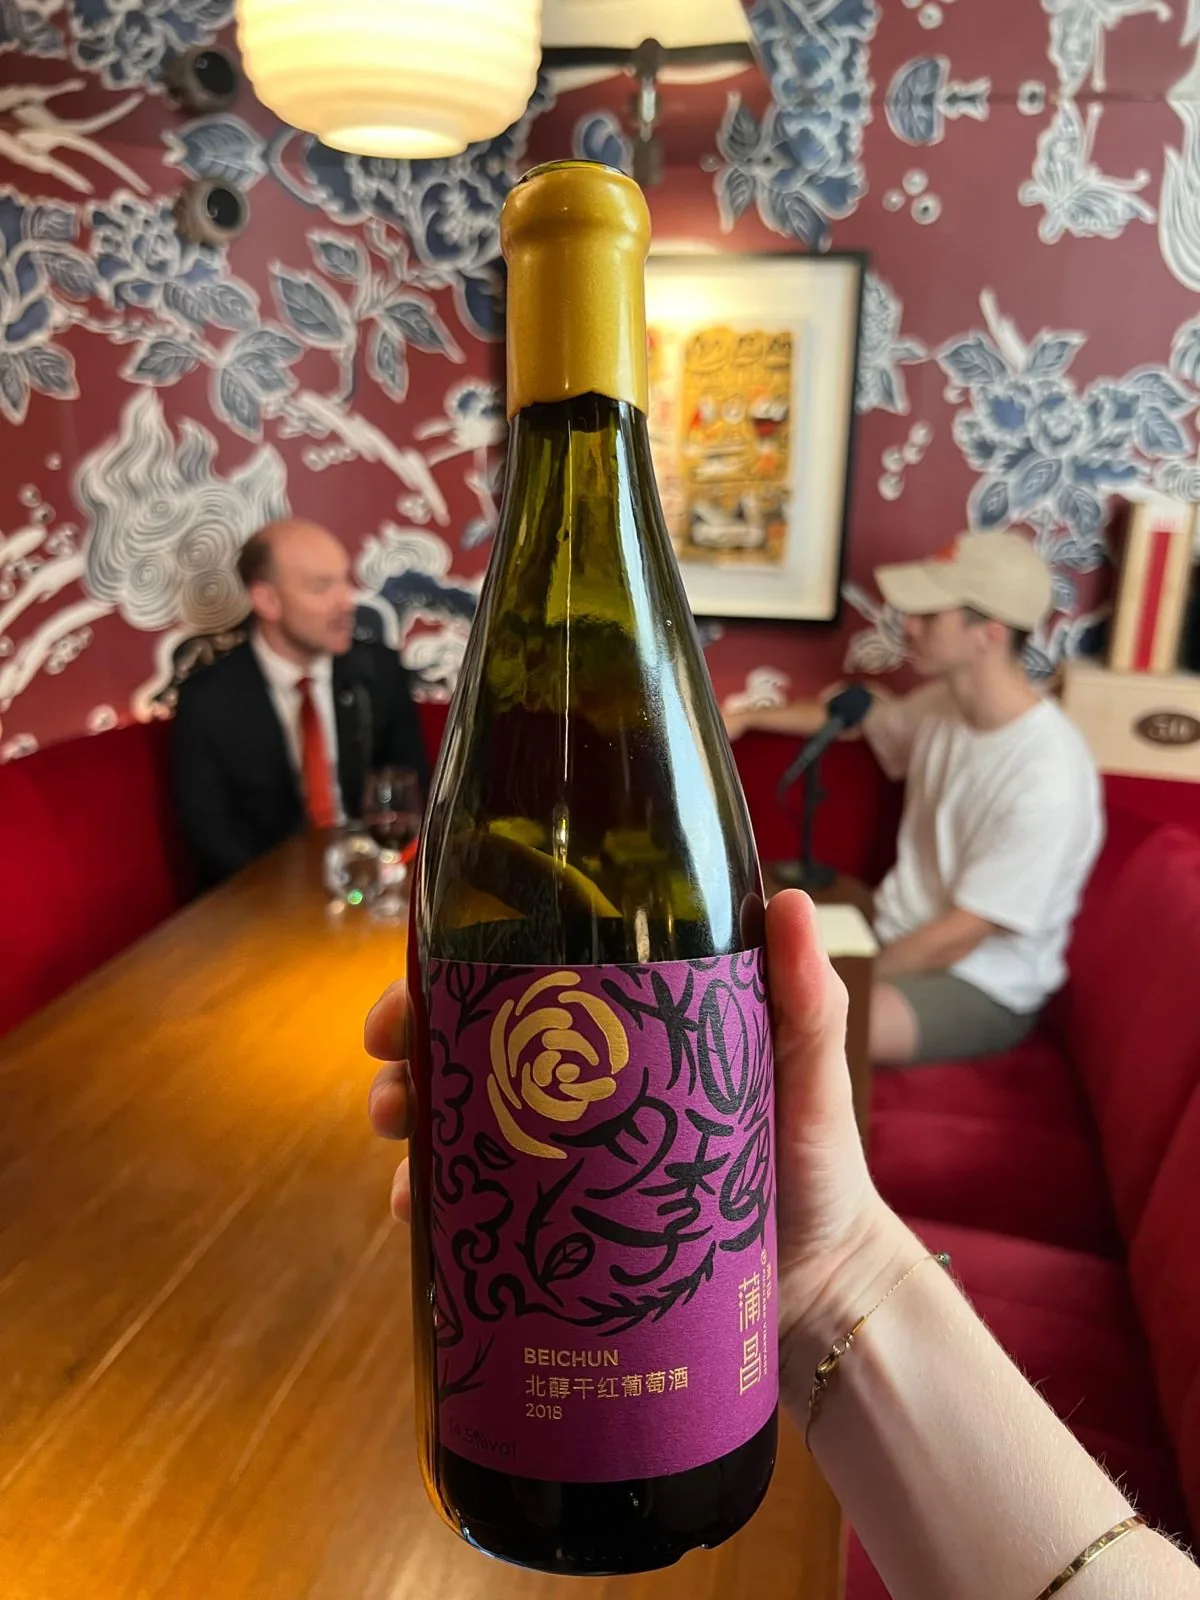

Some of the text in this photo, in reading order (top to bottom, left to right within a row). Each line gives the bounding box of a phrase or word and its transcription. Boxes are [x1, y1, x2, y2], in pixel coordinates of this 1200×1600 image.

[739, 1271, 761, 1396] 蒲昌
[524, 1347, 619, 1367] BEICHUN
[525, 1366, 689, 1399] 北醇干红葡萄酒
[525, 1403, 563, 1420] 2018
